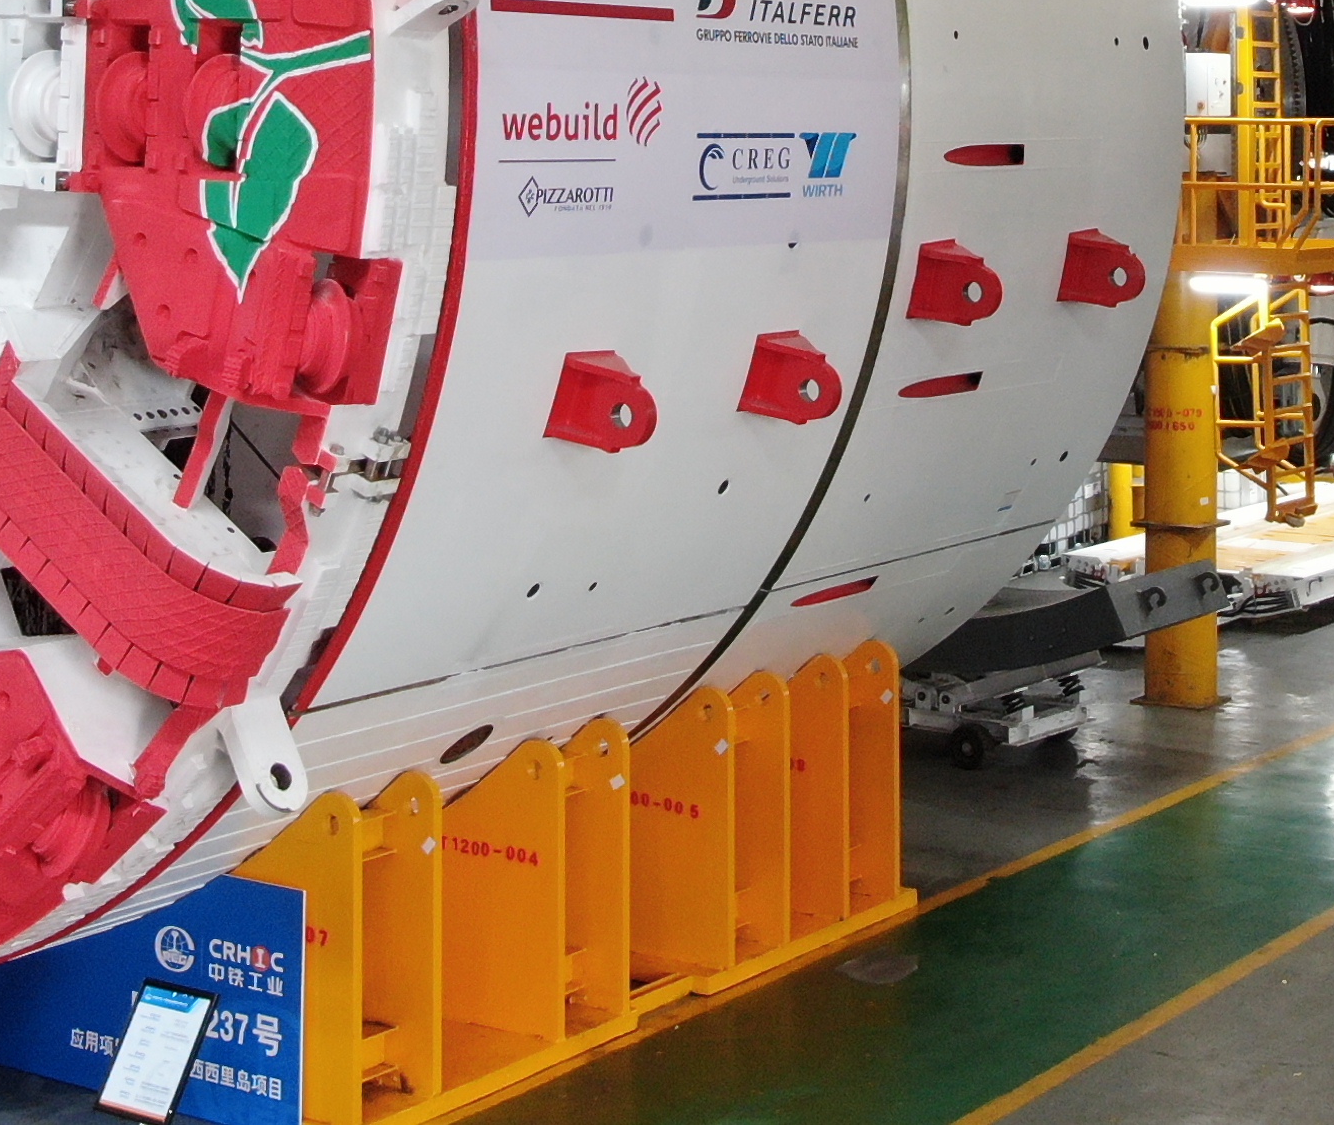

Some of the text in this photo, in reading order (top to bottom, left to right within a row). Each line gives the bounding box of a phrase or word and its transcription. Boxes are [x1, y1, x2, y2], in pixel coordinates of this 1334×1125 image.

[749, 0, 857, 28] ITALFERR
[696, 28, 859, 49] GRUPPO FERROVIE DELLO STATO ITALIANE
[502, 101, 618, 142] webuild
[732, 146, 791, 171] CREG
[535, 186, 614, 205] PIZZAROTTI
[802, 183, 843, 198] WIRTH
[208, 937, 285, 973] CRHIC
[208, 962, 285, 998] 中铁工业
